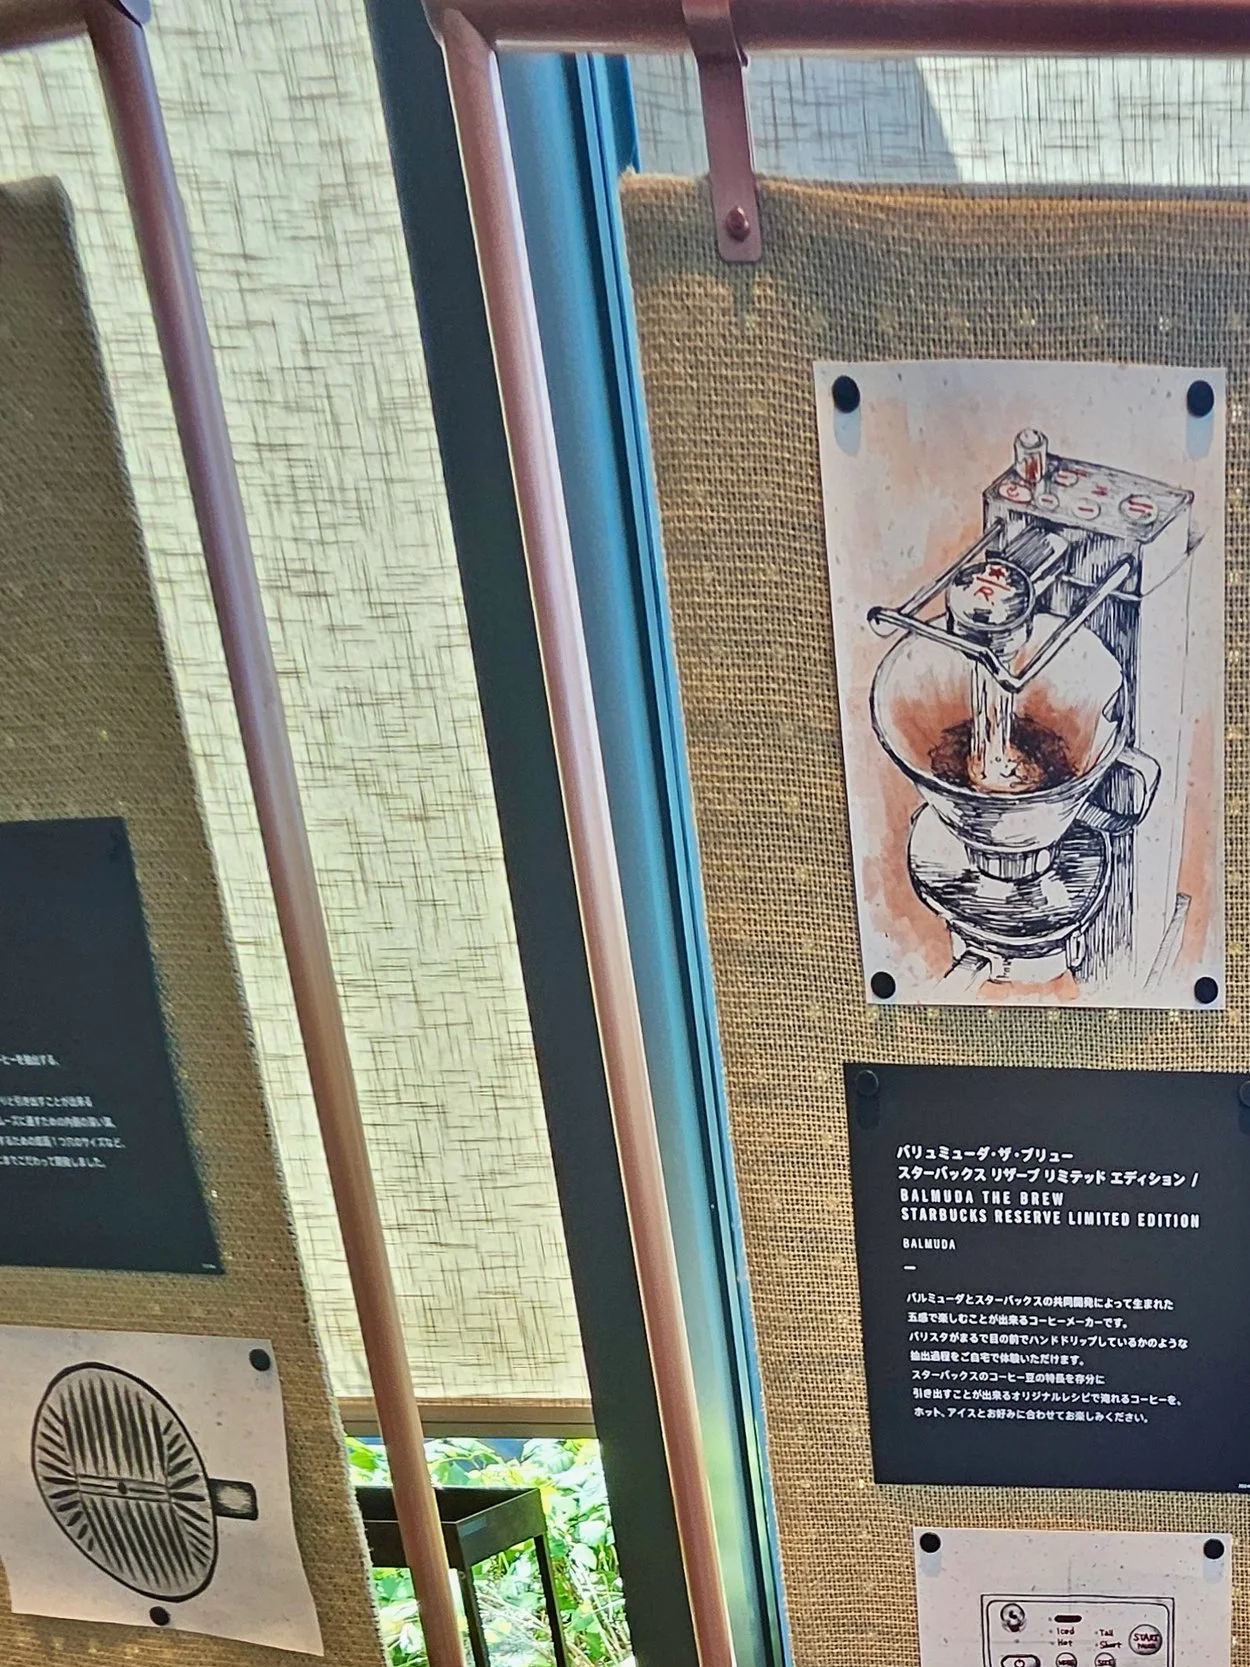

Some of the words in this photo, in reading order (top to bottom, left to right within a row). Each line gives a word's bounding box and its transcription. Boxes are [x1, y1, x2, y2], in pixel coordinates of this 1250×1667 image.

[898, 1164, 987, 1182] スターバックス
[991, 1167, 1041, 1183] リザーブ
[1044, 1168, 1106, 1186] リミテッド
[1110, 1170, 1186, 1187] エディション
[900, 1187, 974, 1204] BALMUDA
[982, 1190, 1012, 1205] THE
[1020, 1191, 1064, 1207] BREW
[901, 1206, 988, 1223] STARBUCKS
[994, 1208, 1061, 1226] RESERVE
[1068, 1210, 1131, 1227] LIMITED
[1137, 1212, 1200, 1229] EDITION
[902, 1237, 956, 1250] BALMUDA
